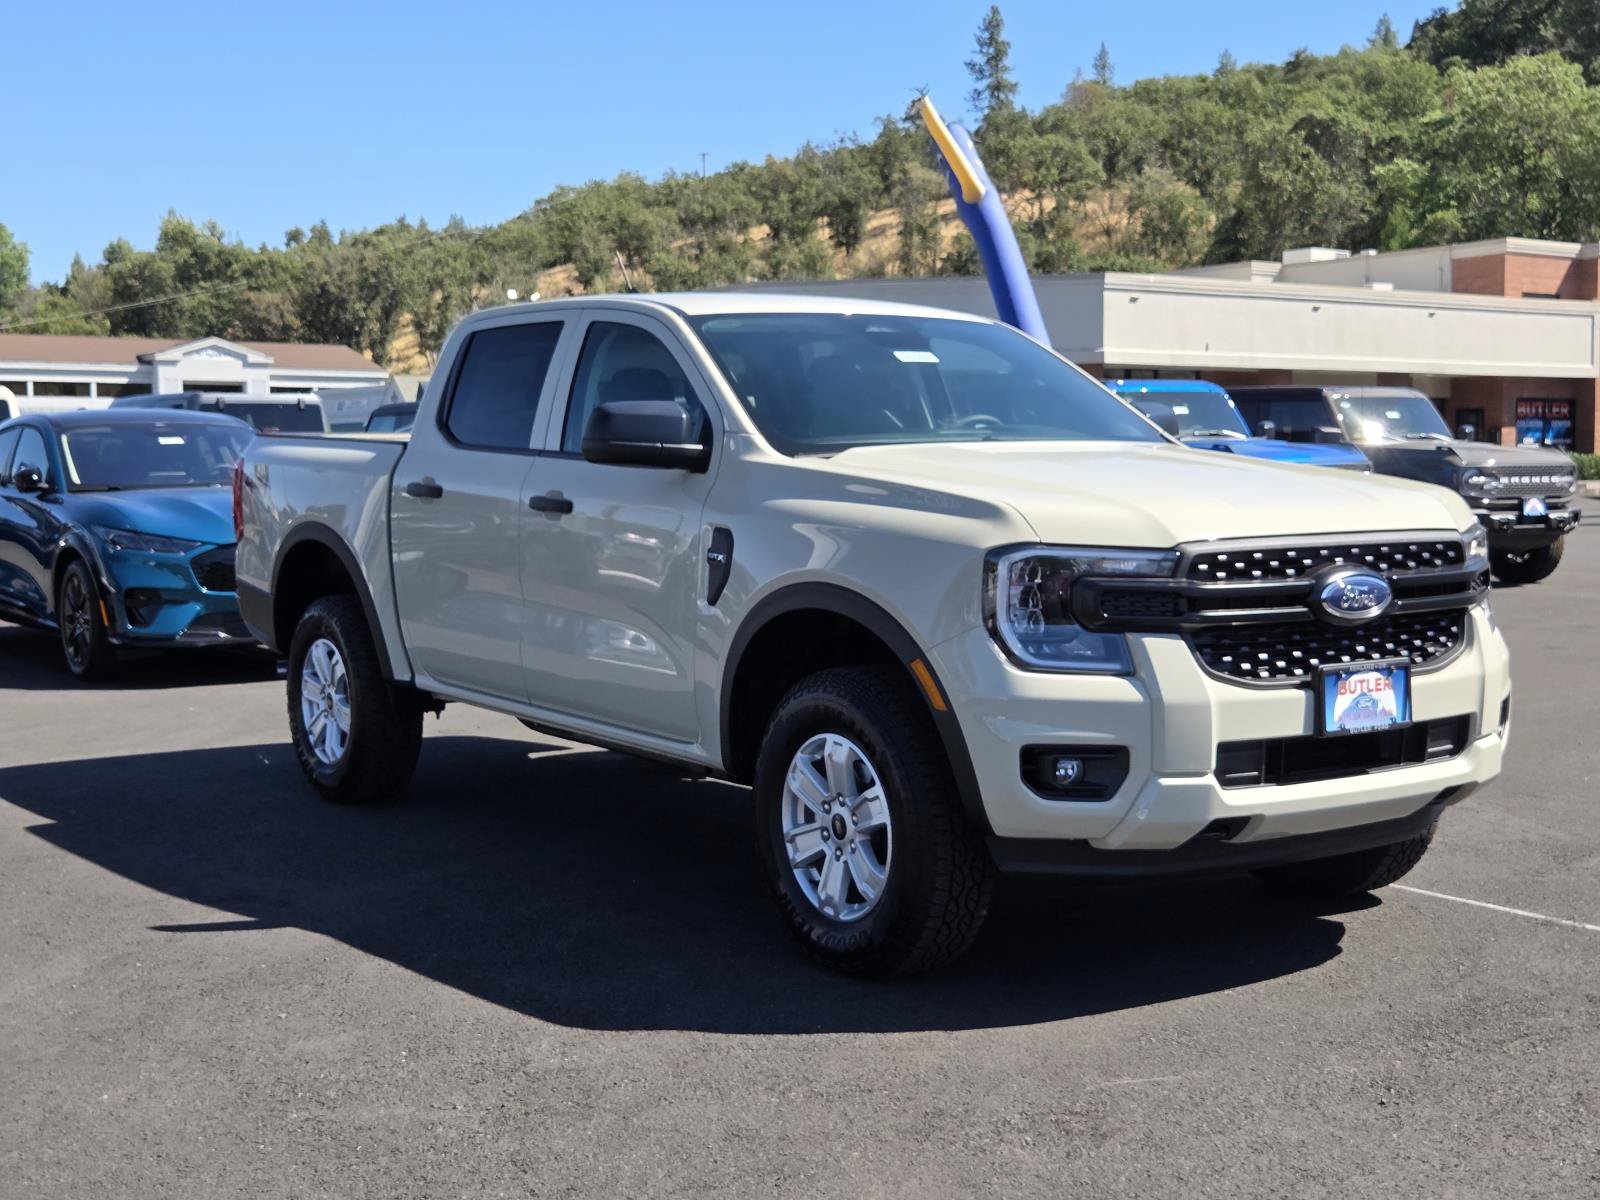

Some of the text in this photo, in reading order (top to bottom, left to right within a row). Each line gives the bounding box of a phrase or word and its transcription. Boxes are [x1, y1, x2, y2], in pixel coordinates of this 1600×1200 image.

[1517, 401, 1569, 418] BUTLER
[1500, 476, 1559, 484] BRONCO
[1341, 585, 1376, 609] Ford
[1337, 678, 1392, 696] BUTLER
